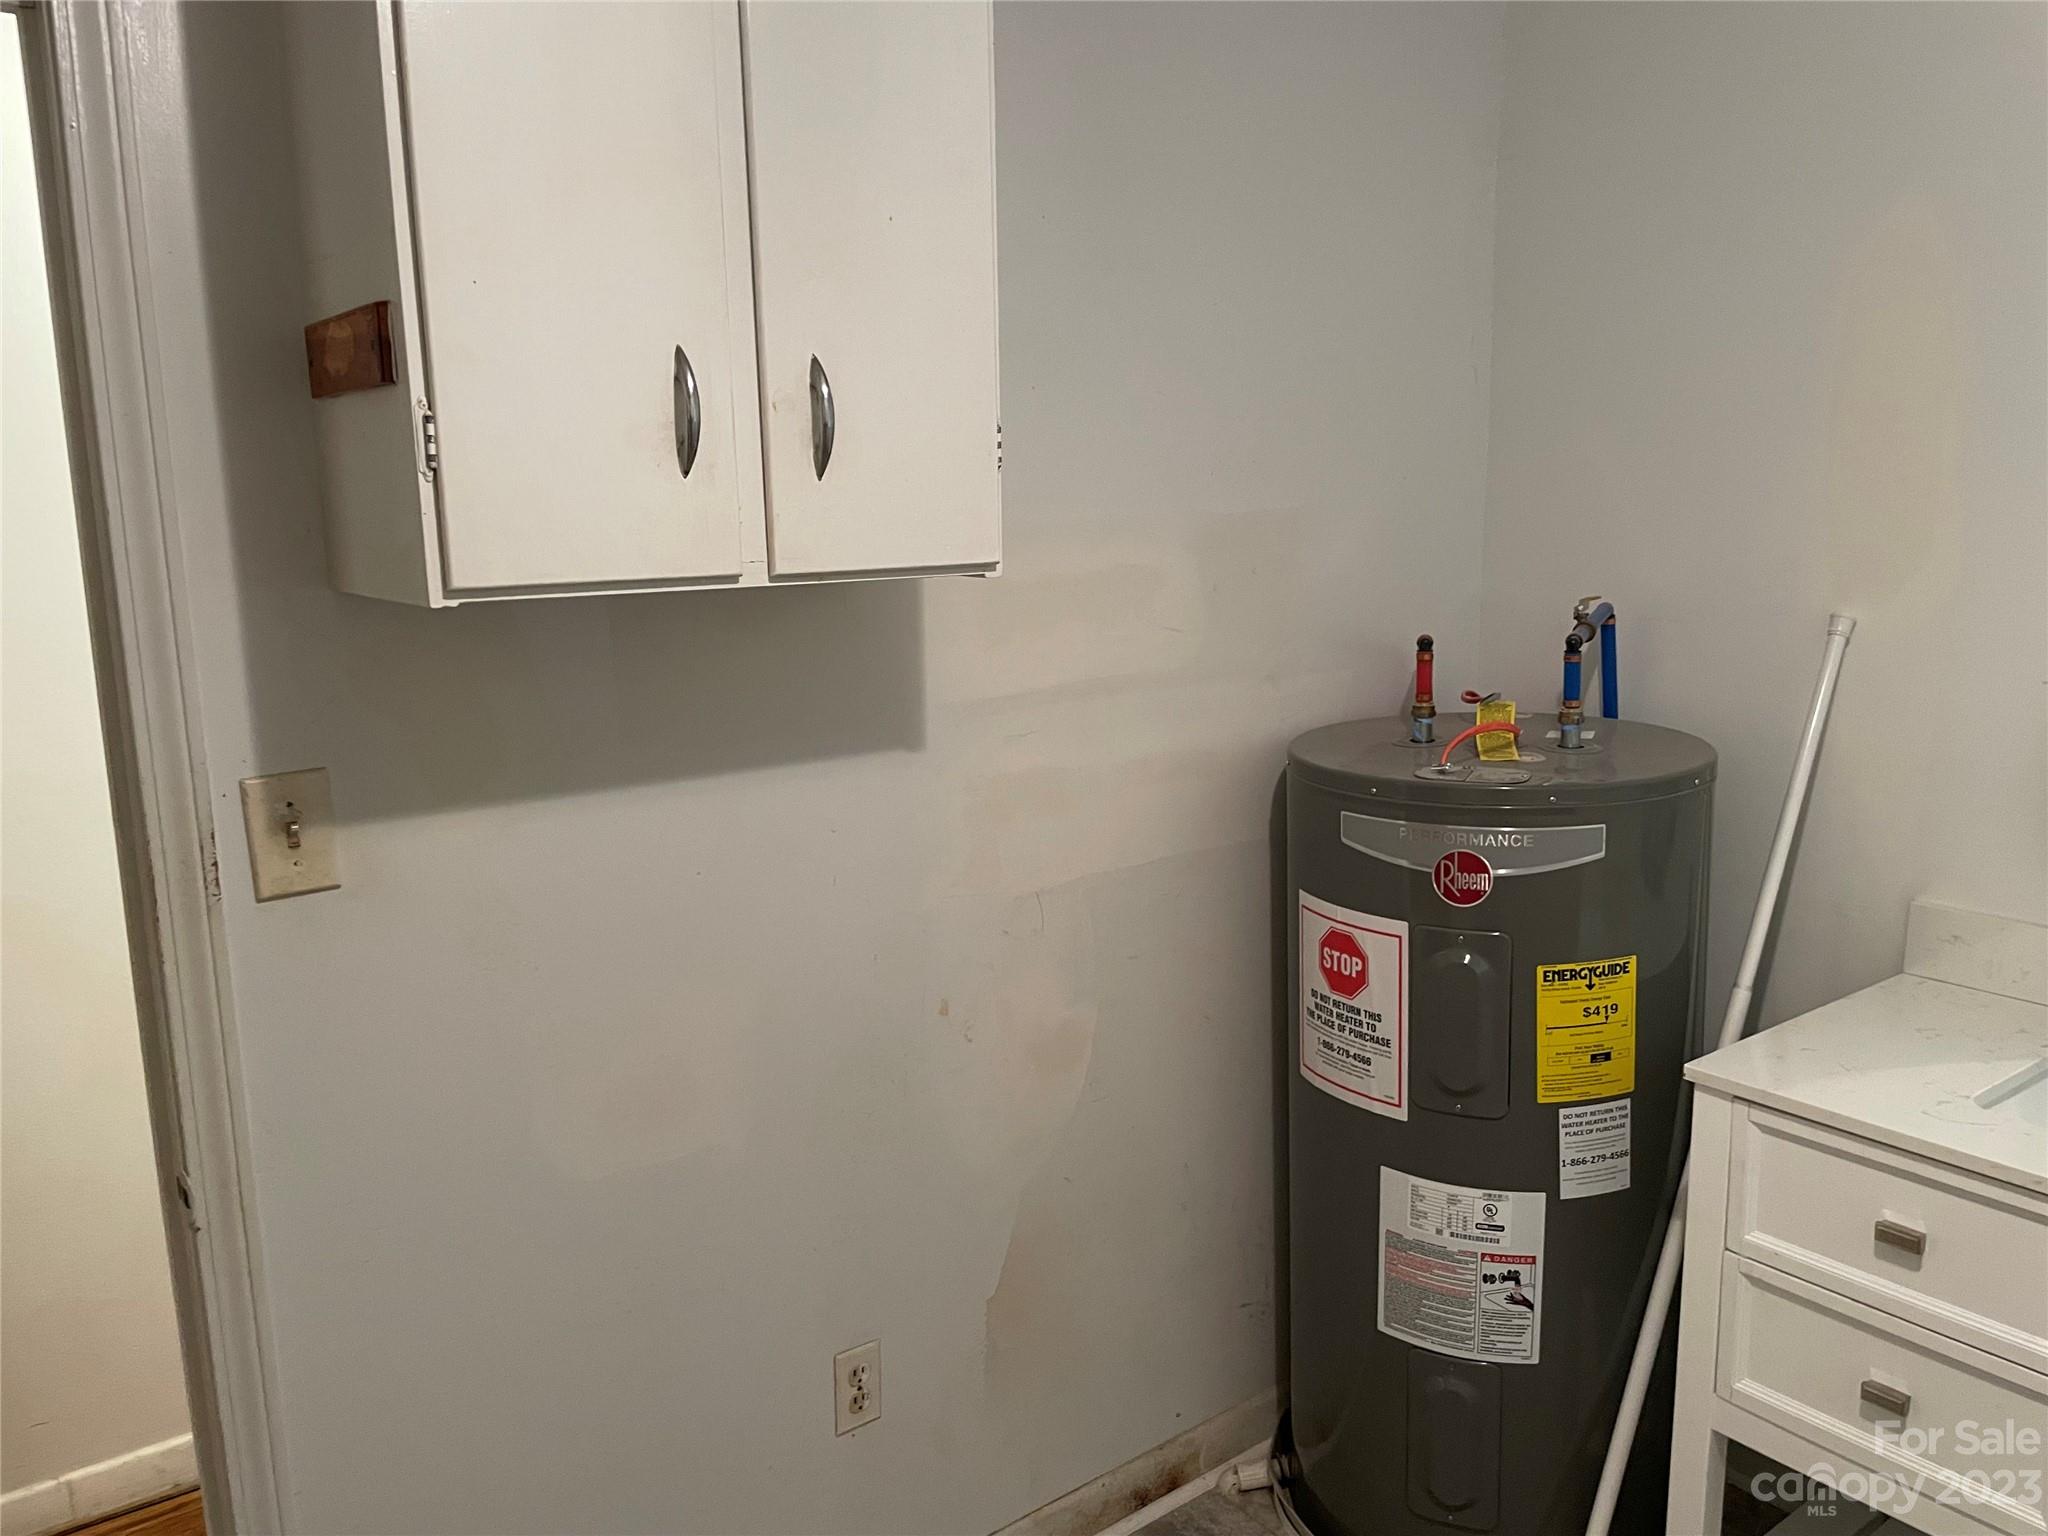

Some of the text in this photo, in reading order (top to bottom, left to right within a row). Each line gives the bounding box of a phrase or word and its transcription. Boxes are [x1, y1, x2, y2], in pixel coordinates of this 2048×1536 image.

[1399, 827, 1535, 848] PERFORMANCE
[1440, 852, 1489, 897] Rheem
[1323, 947, 1363, 978] STOP
[1543, 961, 1630, 984] ENERGYGUIDE
[1314, 1000, 1376, 1033] WATER HEATER TO
[1320, 993, 1331, 1006] NOT
[1332, 999, 1361, 1017] RETURN
[1363, 1009, 1382, 1023] THIS
[1582, 1003, 1618, 1018] $419
[1317, 1012, 1336, 1030] PLACE
[1337, 1023, 1347, 1034] OF
[1349, 1027, 1391, 1048] PURCHASE
[1561, 1121, 1584, 1129] WATER
[1585, 1117, 1608, 1126] HEATER
[1589, 1108, 1614, 1117] RETURN
[1564, 1129, 1584, 1137] PLACE
[1595, 1122, 1626, 1134] PURCHASE
[1561, 1148, 1630, 1168] 1-866-279-4566
[1493, 1255, 1533, 1264] DANGER
